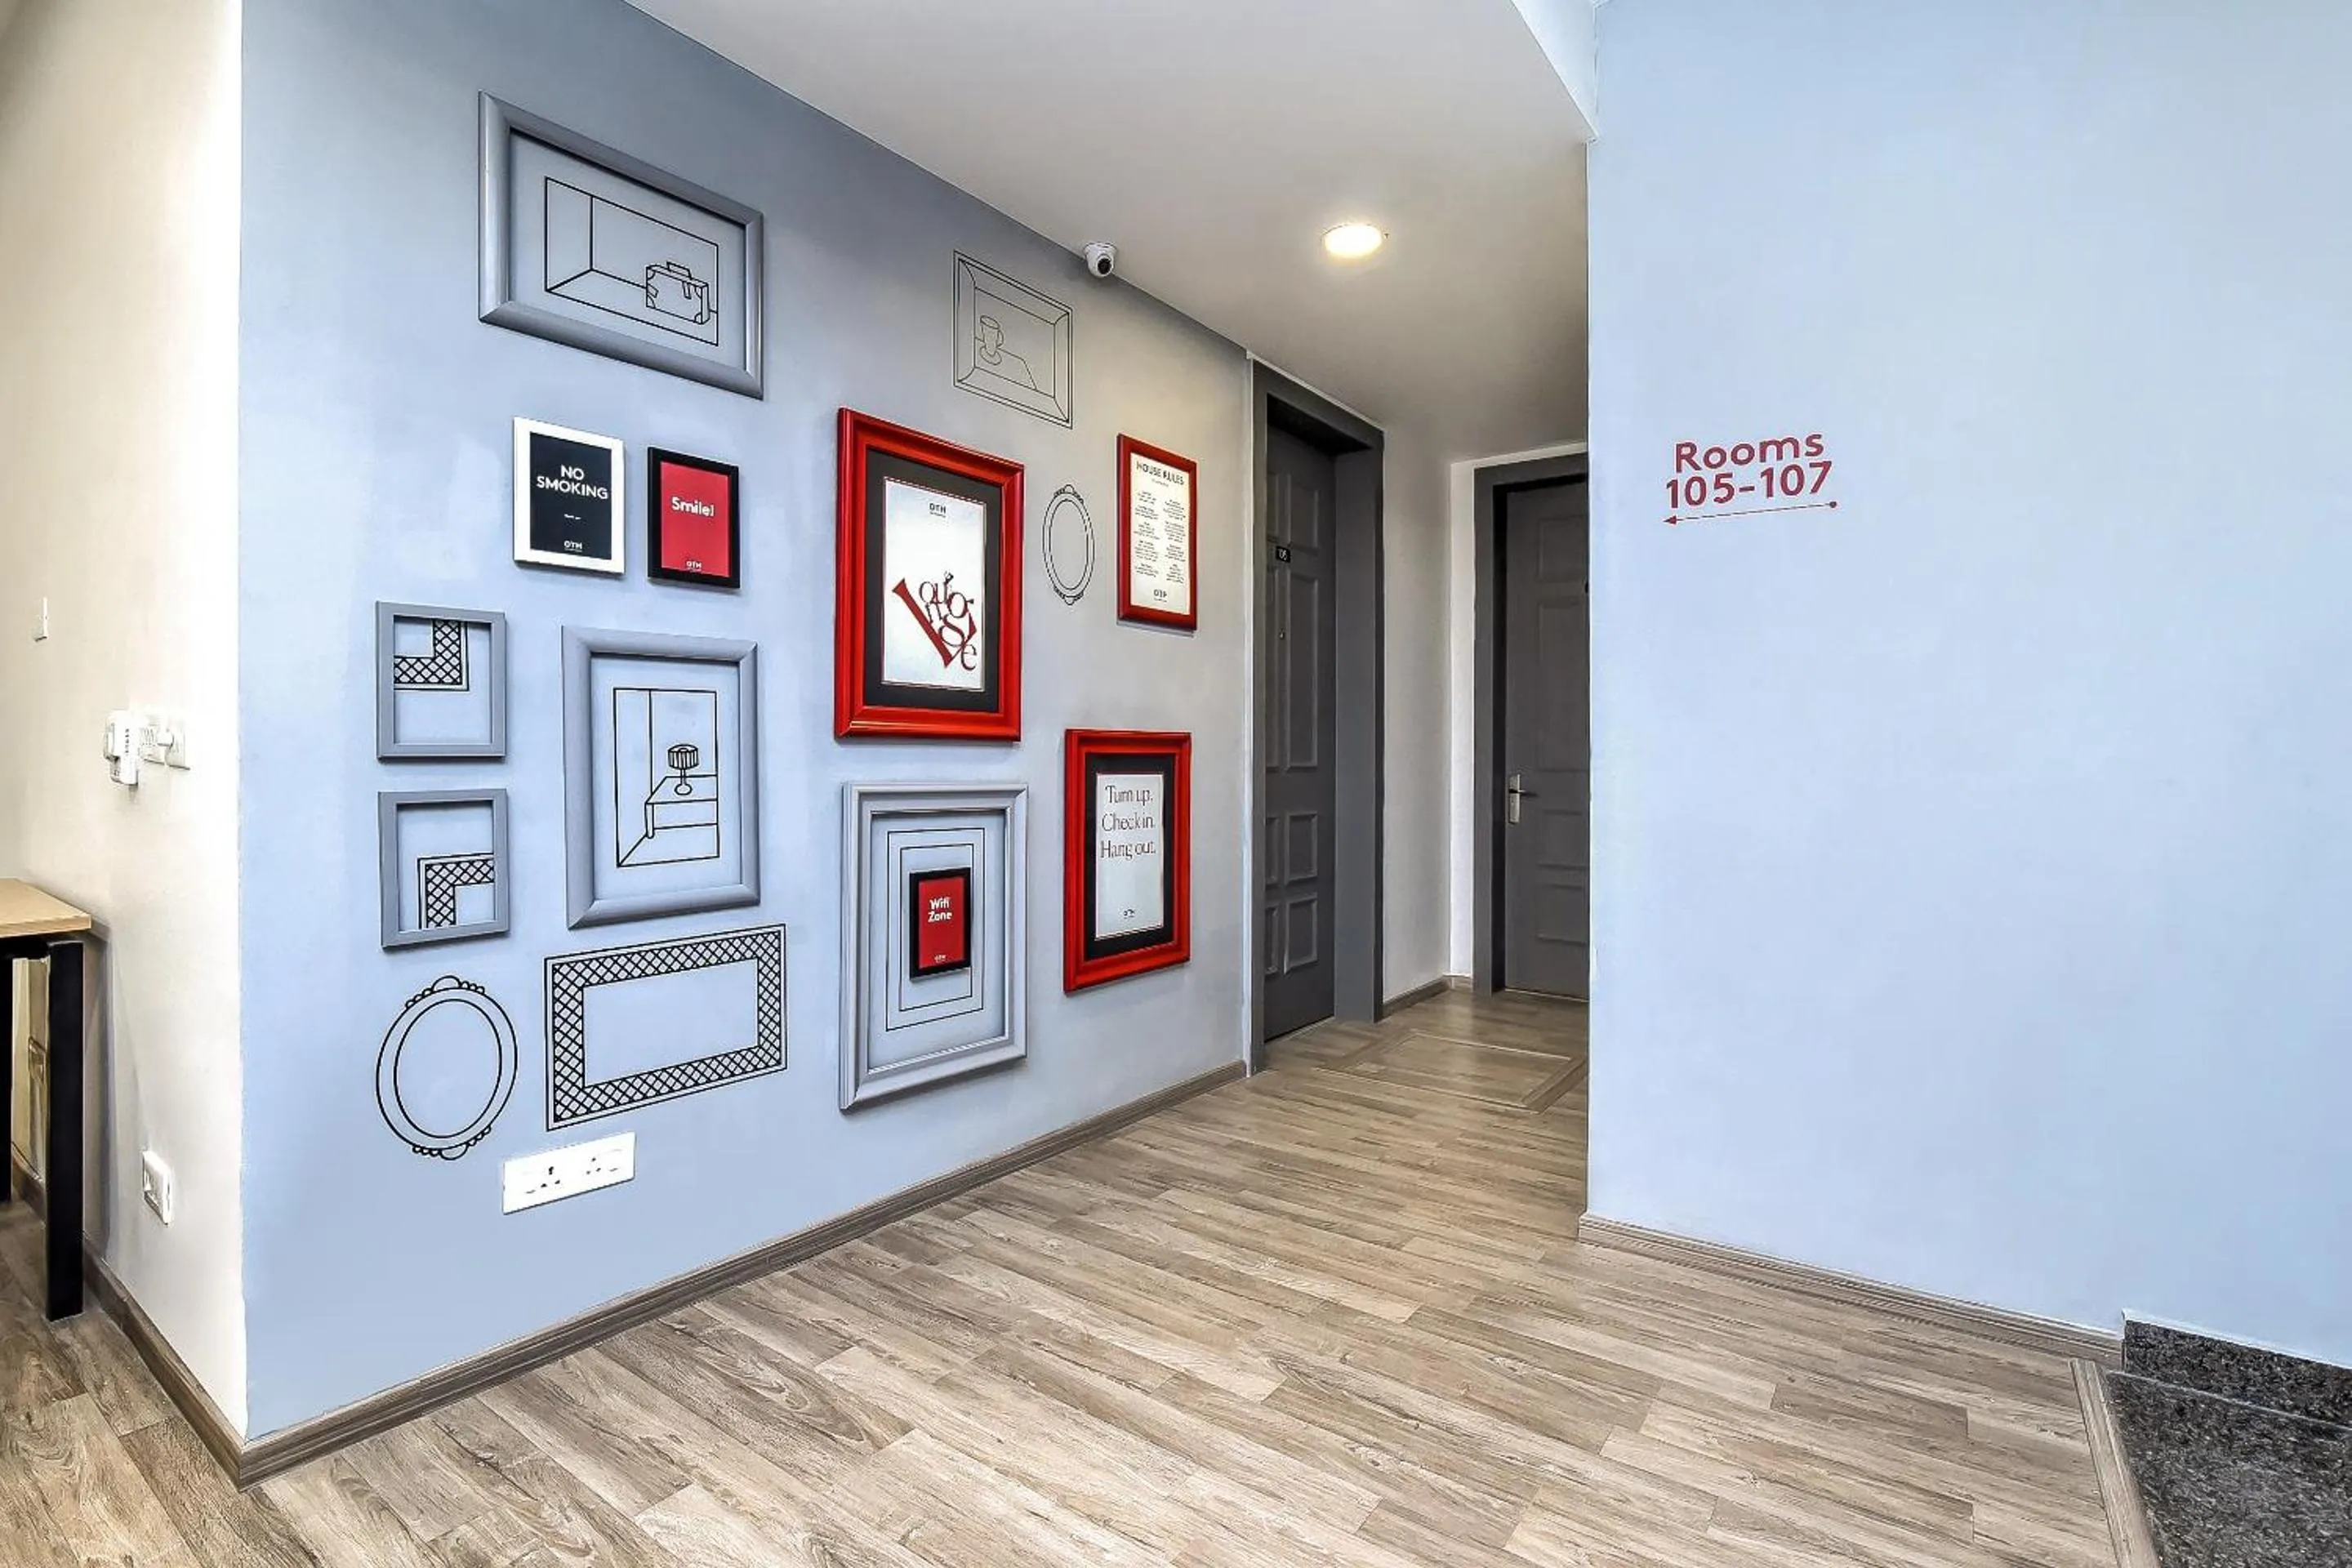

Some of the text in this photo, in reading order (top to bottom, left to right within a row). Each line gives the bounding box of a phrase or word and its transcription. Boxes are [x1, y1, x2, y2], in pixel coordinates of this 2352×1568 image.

[1674, 434, 1824, 474] Rooms
[561, 465, 585, 480] NO
[1136, 460, 1161, 477] HOUSE
[1163, 470, 1184, 485] RULES
[537, 476, 608, 500] SMOKING
[1666, 461, 1833, 509] 105-107
[1105, 785, 1154, 807] Turn up.
[1102, 812, 1140, 831] Check
[1100, 840, 1133, 861] Hang
[928, 911, 953, 924] Zone
